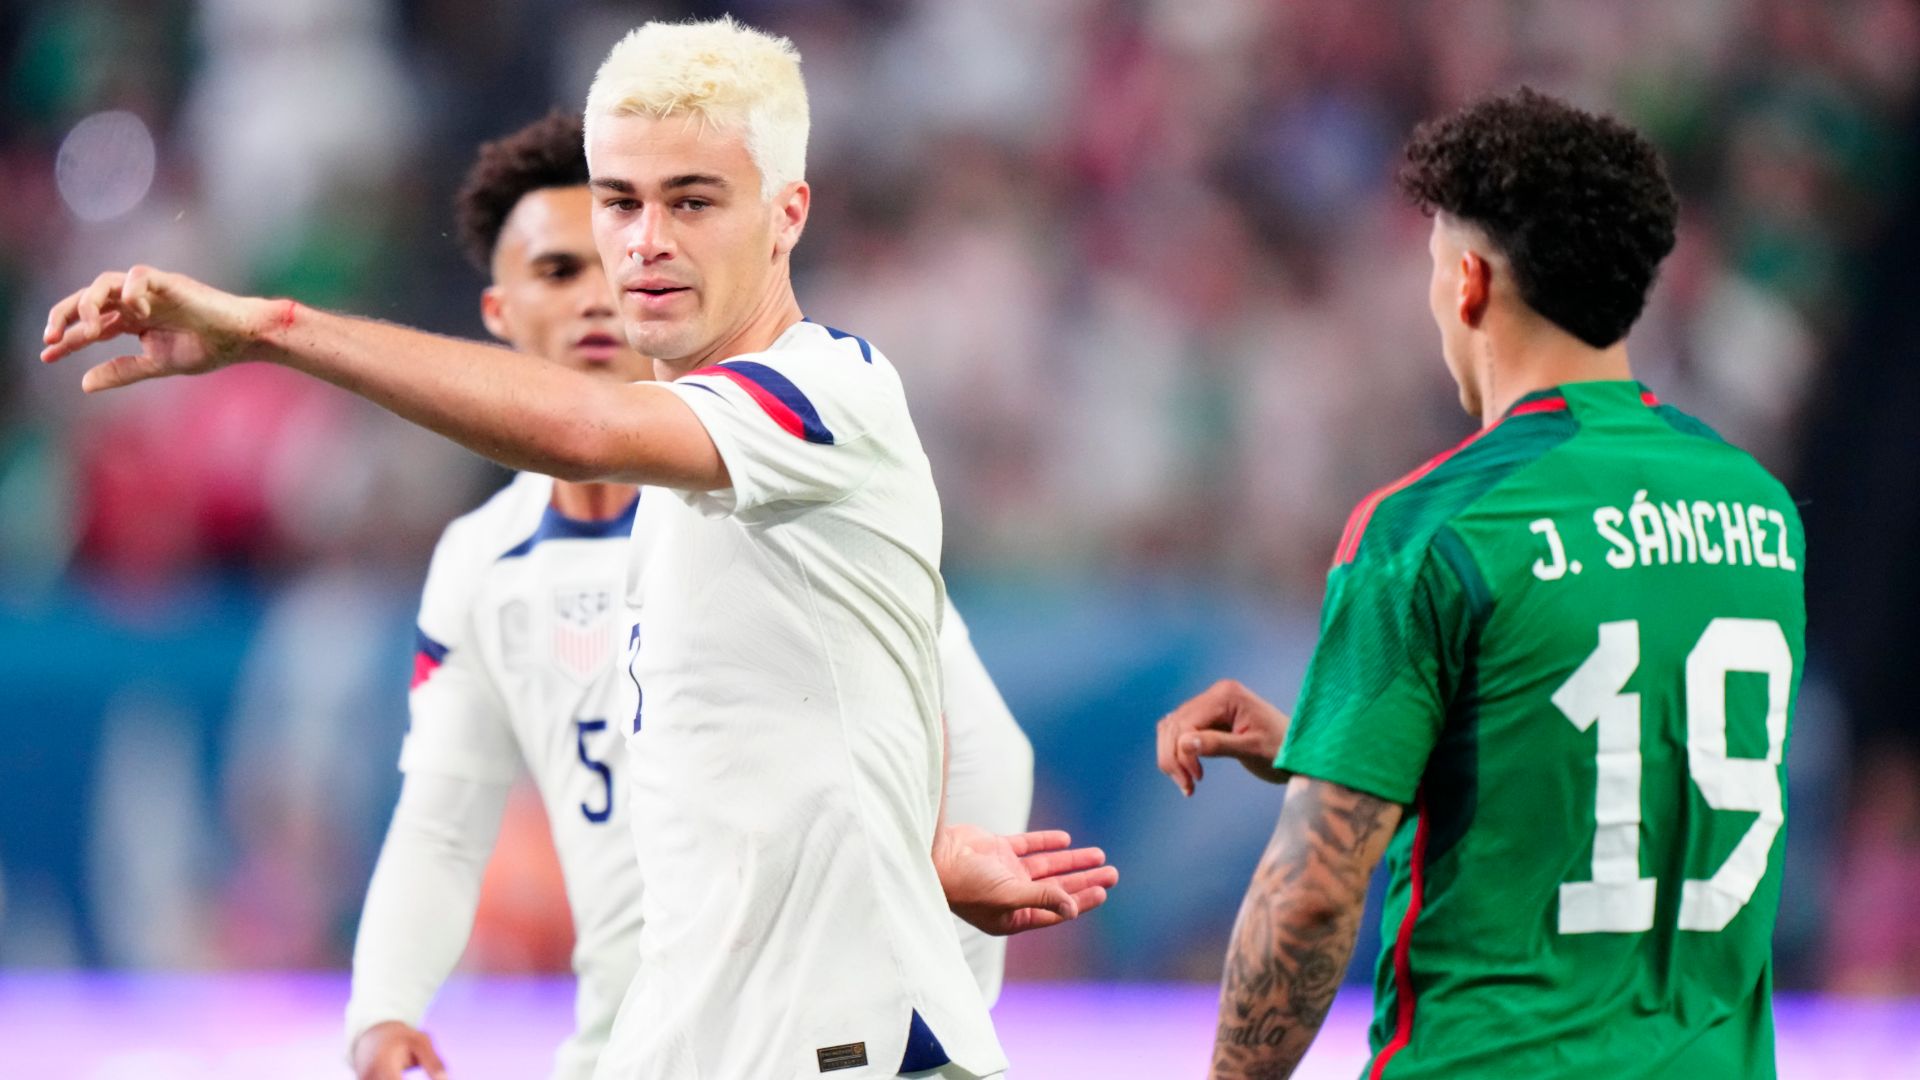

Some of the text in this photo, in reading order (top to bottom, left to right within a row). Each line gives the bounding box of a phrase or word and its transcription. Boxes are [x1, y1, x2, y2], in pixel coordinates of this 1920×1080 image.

[1530, 489, 1796, 580] J. SÁNCHEZ
[555, 588, 610, 627] USA
[577, 718, 613, 823] 5
[1551, 617, 1793, 934] 19
